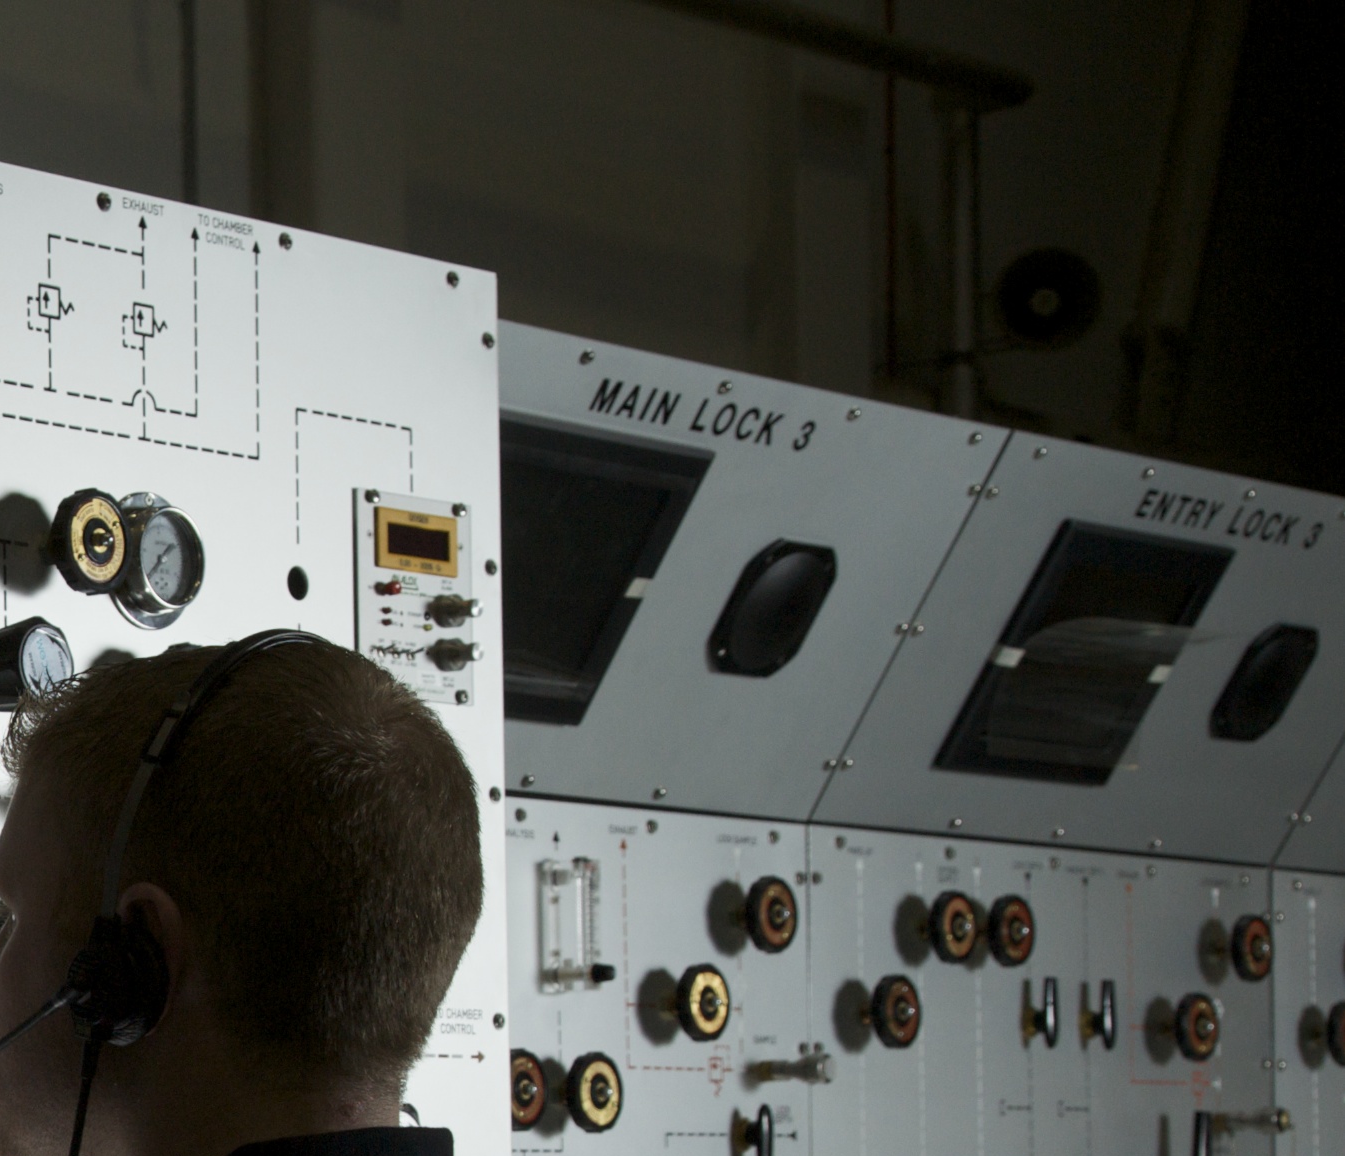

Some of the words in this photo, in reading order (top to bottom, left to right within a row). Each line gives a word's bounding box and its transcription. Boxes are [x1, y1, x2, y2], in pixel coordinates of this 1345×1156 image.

[122, 197, 165, 216] EXHAUST
[198, 213, 210, 227] TO
[212, 217, 254, 236] CHAMBER
[206, 232, 246, 251] CONTROL
[589, 378, 682, 426] MAIN
[689, 397, 786, 446] LOCK
[792, 420, 817, 451] 3
[1134, 487, 1226, 530] ENTRY
[1226, 505, 1301, 546] LOCK
[1304, 522, 1325, 549] 3
